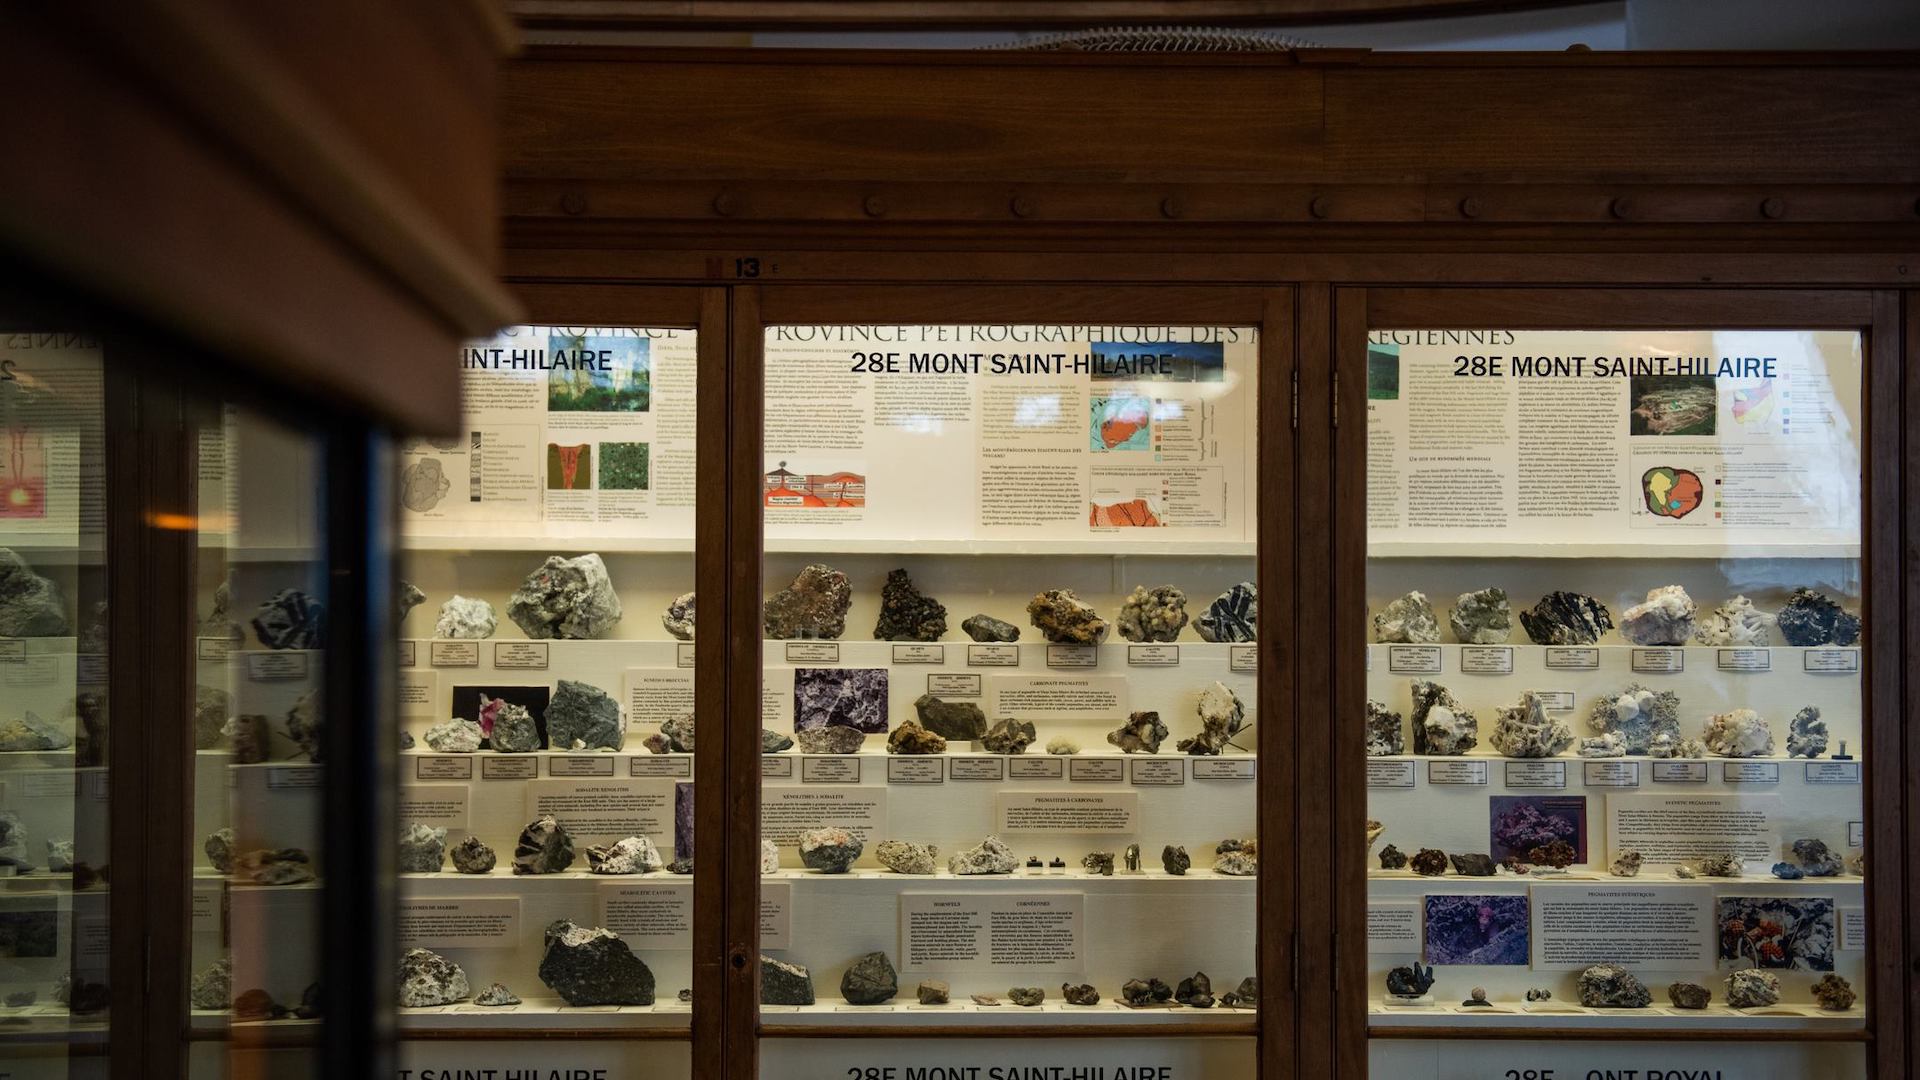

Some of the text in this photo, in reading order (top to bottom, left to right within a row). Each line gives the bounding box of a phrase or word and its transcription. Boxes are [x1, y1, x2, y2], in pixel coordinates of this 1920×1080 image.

[767, 325, 907, 342] ROVINCE
[463, 348, 612, 371] INT-HILAIRE
[851, 352, 1173, 375] 28E MONT SAINT-HILAIRE
[1454, 355, 1777, 378] 28E MONT SAINT-HILAIRE
[847, 1067, 897, 1080] 28E
[906, 1067, 981, 1080] MONT
